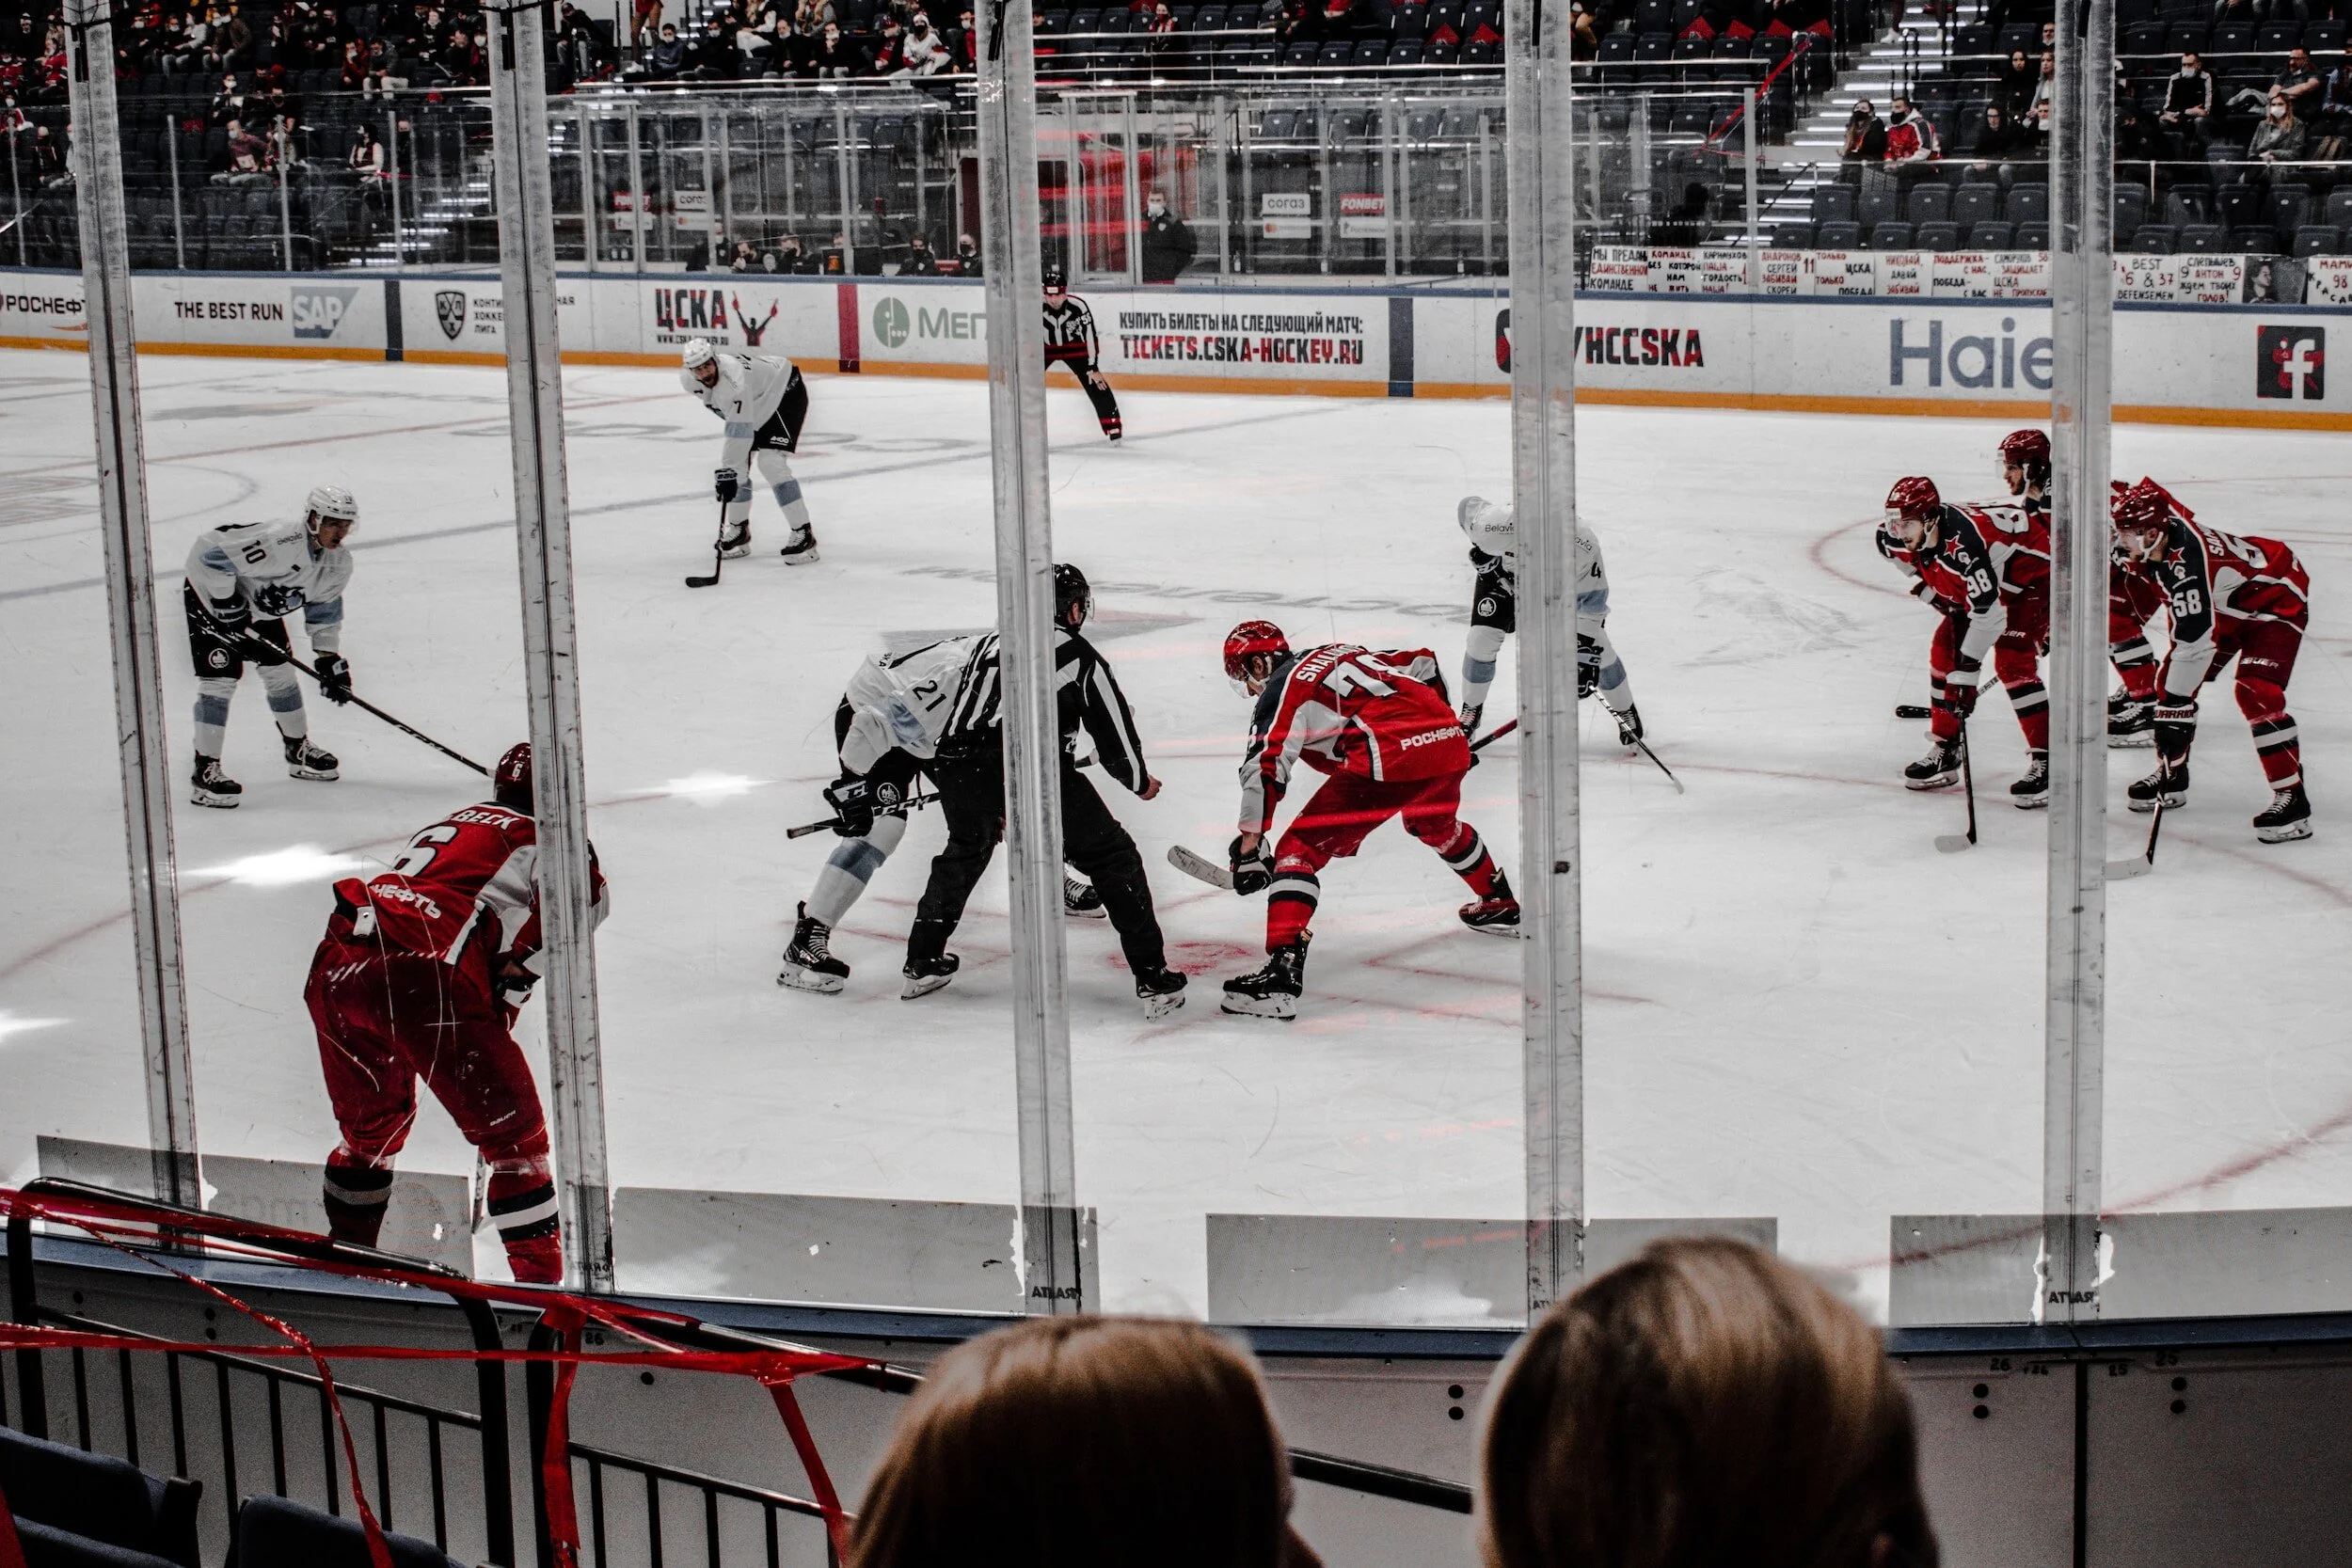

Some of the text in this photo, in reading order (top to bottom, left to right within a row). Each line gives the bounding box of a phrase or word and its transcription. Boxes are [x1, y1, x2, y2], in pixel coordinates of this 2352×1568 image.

[1341, 198, 1385, 210] FONBET
[1594, 248, 1607, 261] МЫ
[1803, 259, 1815, 274] 11
[2133, 258, 2163, 270] BEST
[1703, 274, 1742, 282] ГОРДОСТЬ
[1816, 277, 1844, 285] ТОЛЬКО
[2144, 273, 2154, 288] &
[2158, 273, 2173, 285] 37
[2181, 265, 2189, 278] 9
[2233, 266, 2241, 281] 9
[1590, 277, 1633, 291] КОМАНДЕ
[2333, 275, 2347, 288] 98
[2118, 290, 2173, 300] DEFENSEMEN
[174, 302, 283, 322] THE BEST RUN
[293, 294, 344, 329] SAP
[473, 311, 503, 322] ХОККЕ
[655, 289, 728, 332] ЦСКА
[474, 325, 497, 335] ЛИГА
[1120, 311, 1363, 335] КУПИТЬ БИЛЕТЫ НА СЛЕДУЮЩИЙ МАТЧ:
[1120, 335, 1363, 365] TICKETS.CSKA-HOCKEY.RU
[1890, 317, 2053, 389] Haie
[733, 401, 742, 414] 7
[242, 540, 267, 564] 10
[1590, 562, 1601, 578] 4
[1966, 568, 1994, 599] 98
[2172, 589, 2202, 618] 58
[1323, 654, 1427, 699] 78
[913, 679, 947, 713] 21
[513, 763, 522, 779] 6
[451, 809, 520, 831] BECK
[391, 825, 459, 878] 6
[369, 883, 442, 919] НЕФТЬ
